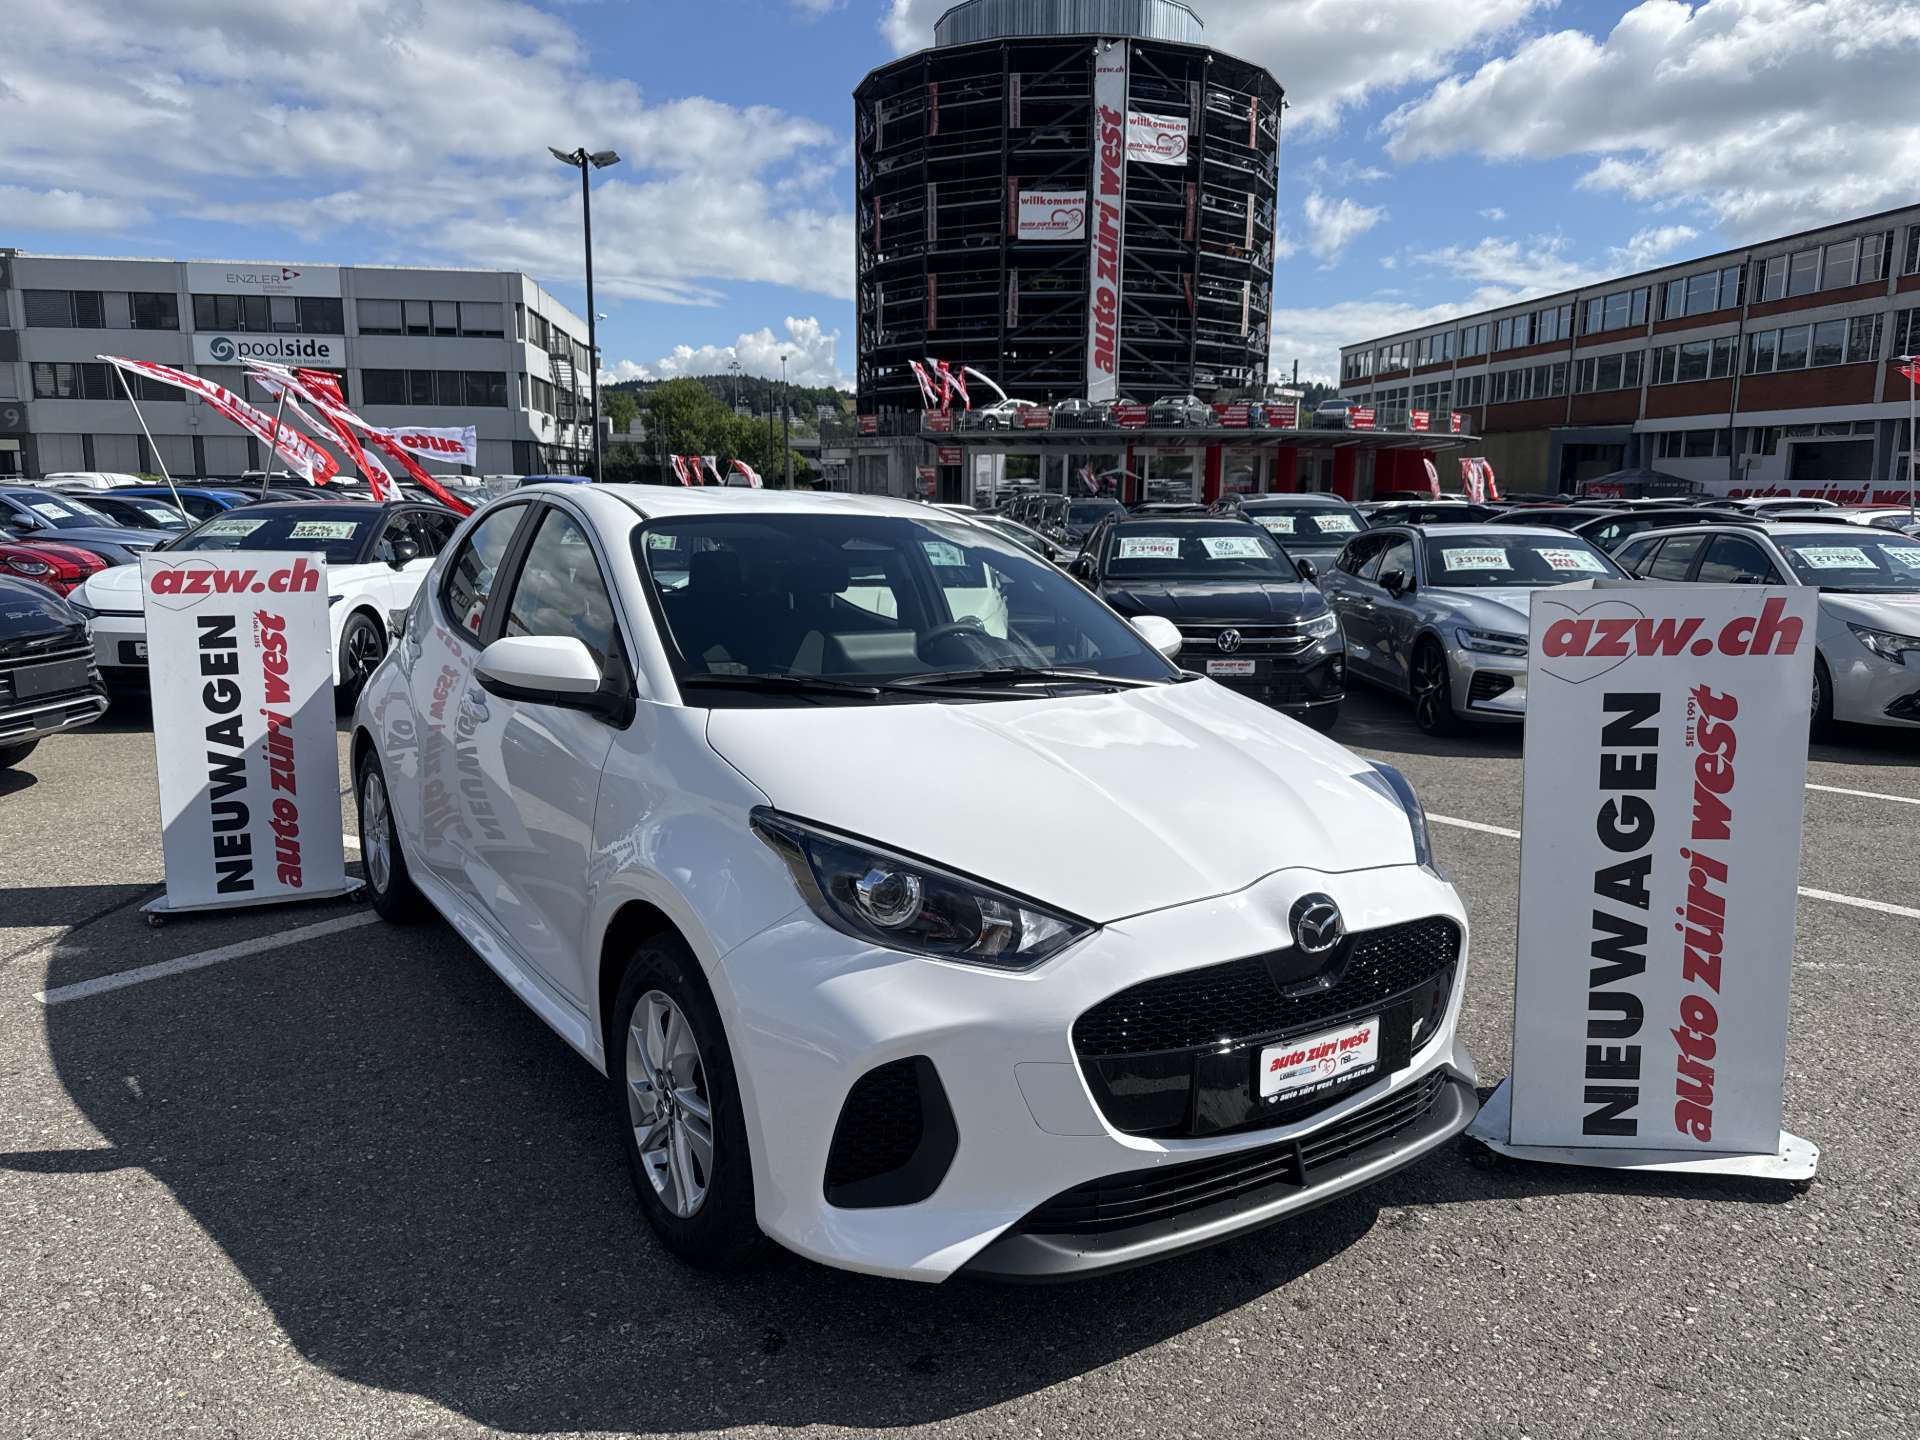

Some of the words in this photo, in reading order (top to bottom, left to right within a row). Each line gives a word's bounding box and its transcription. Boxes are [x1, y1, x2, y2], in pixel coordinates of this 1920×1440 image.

[1097, 65, 1124, 73] azw.ch
[1099, 104, 1121, 195] west
[1129, 116, 1187, 131] willkommen
[1021, 195, 1084, 206] willkommen
[1093, 199, 1119, 285] züri
[226, 273, 280, 284] ENZLER
[238, 338, 330, 358] poolside
[1092, 287, 1116, 374] auto
[3, 408, 20, 428] 9
[151, 558, 319, 594] azw.ch
[253, 609, 290, 703] west
[1542, 597, 1803, 657] azw.ch
[1685, 726, 1695, 747] SEIT
[1686, 696, 1697, 723] 1991
[197, 616, 254, 894] NEUWAGEN
[259, 708, 296, 795] züri
[1689, 684, 1738, 840] west
[267, 798, 302, 888] auto
[1582, 693, 1661, 1136] NEUWAGEN
[1674, 847, 1728, 994] züri
[1270, 1050, 1306, 1072] auto
[1307, 1037, 1339, 1061] züri
[1340, 1029, 1371, 1051] west
[1670, 995, 1719, 1142] auto
[1279, 1090, 1298, 1101] auto
[1316, 1079, 1333, 1090] west
